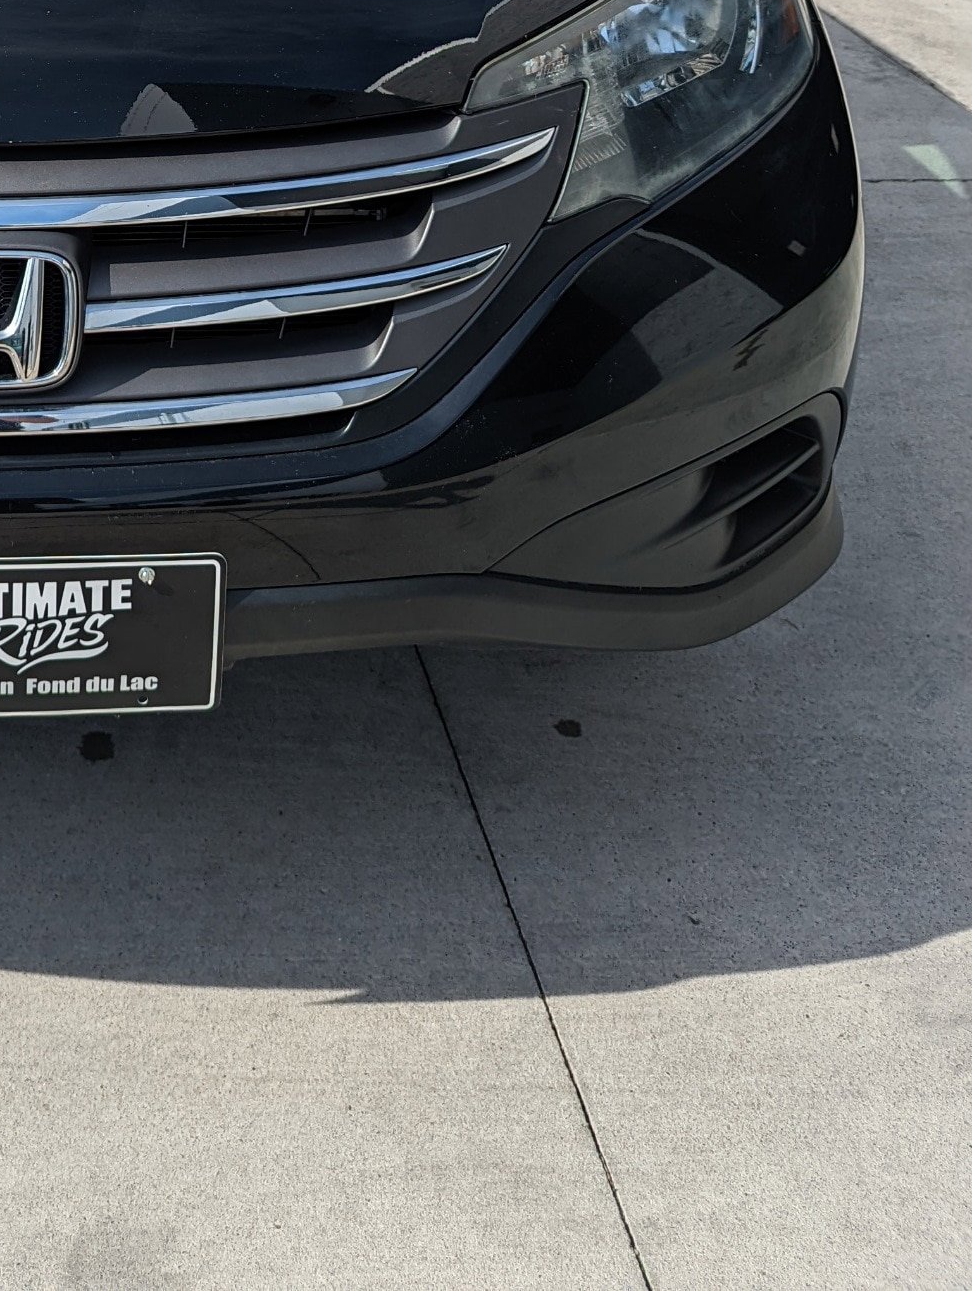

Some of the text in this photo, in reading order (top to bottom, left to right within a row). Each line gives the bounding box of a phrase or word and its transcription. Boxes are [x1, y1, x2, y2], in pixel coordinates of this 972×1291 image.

[26, 677, 80, 694] Fond
[86, 676, 114, 693] du
[120, 675, 158, 691] Lac
